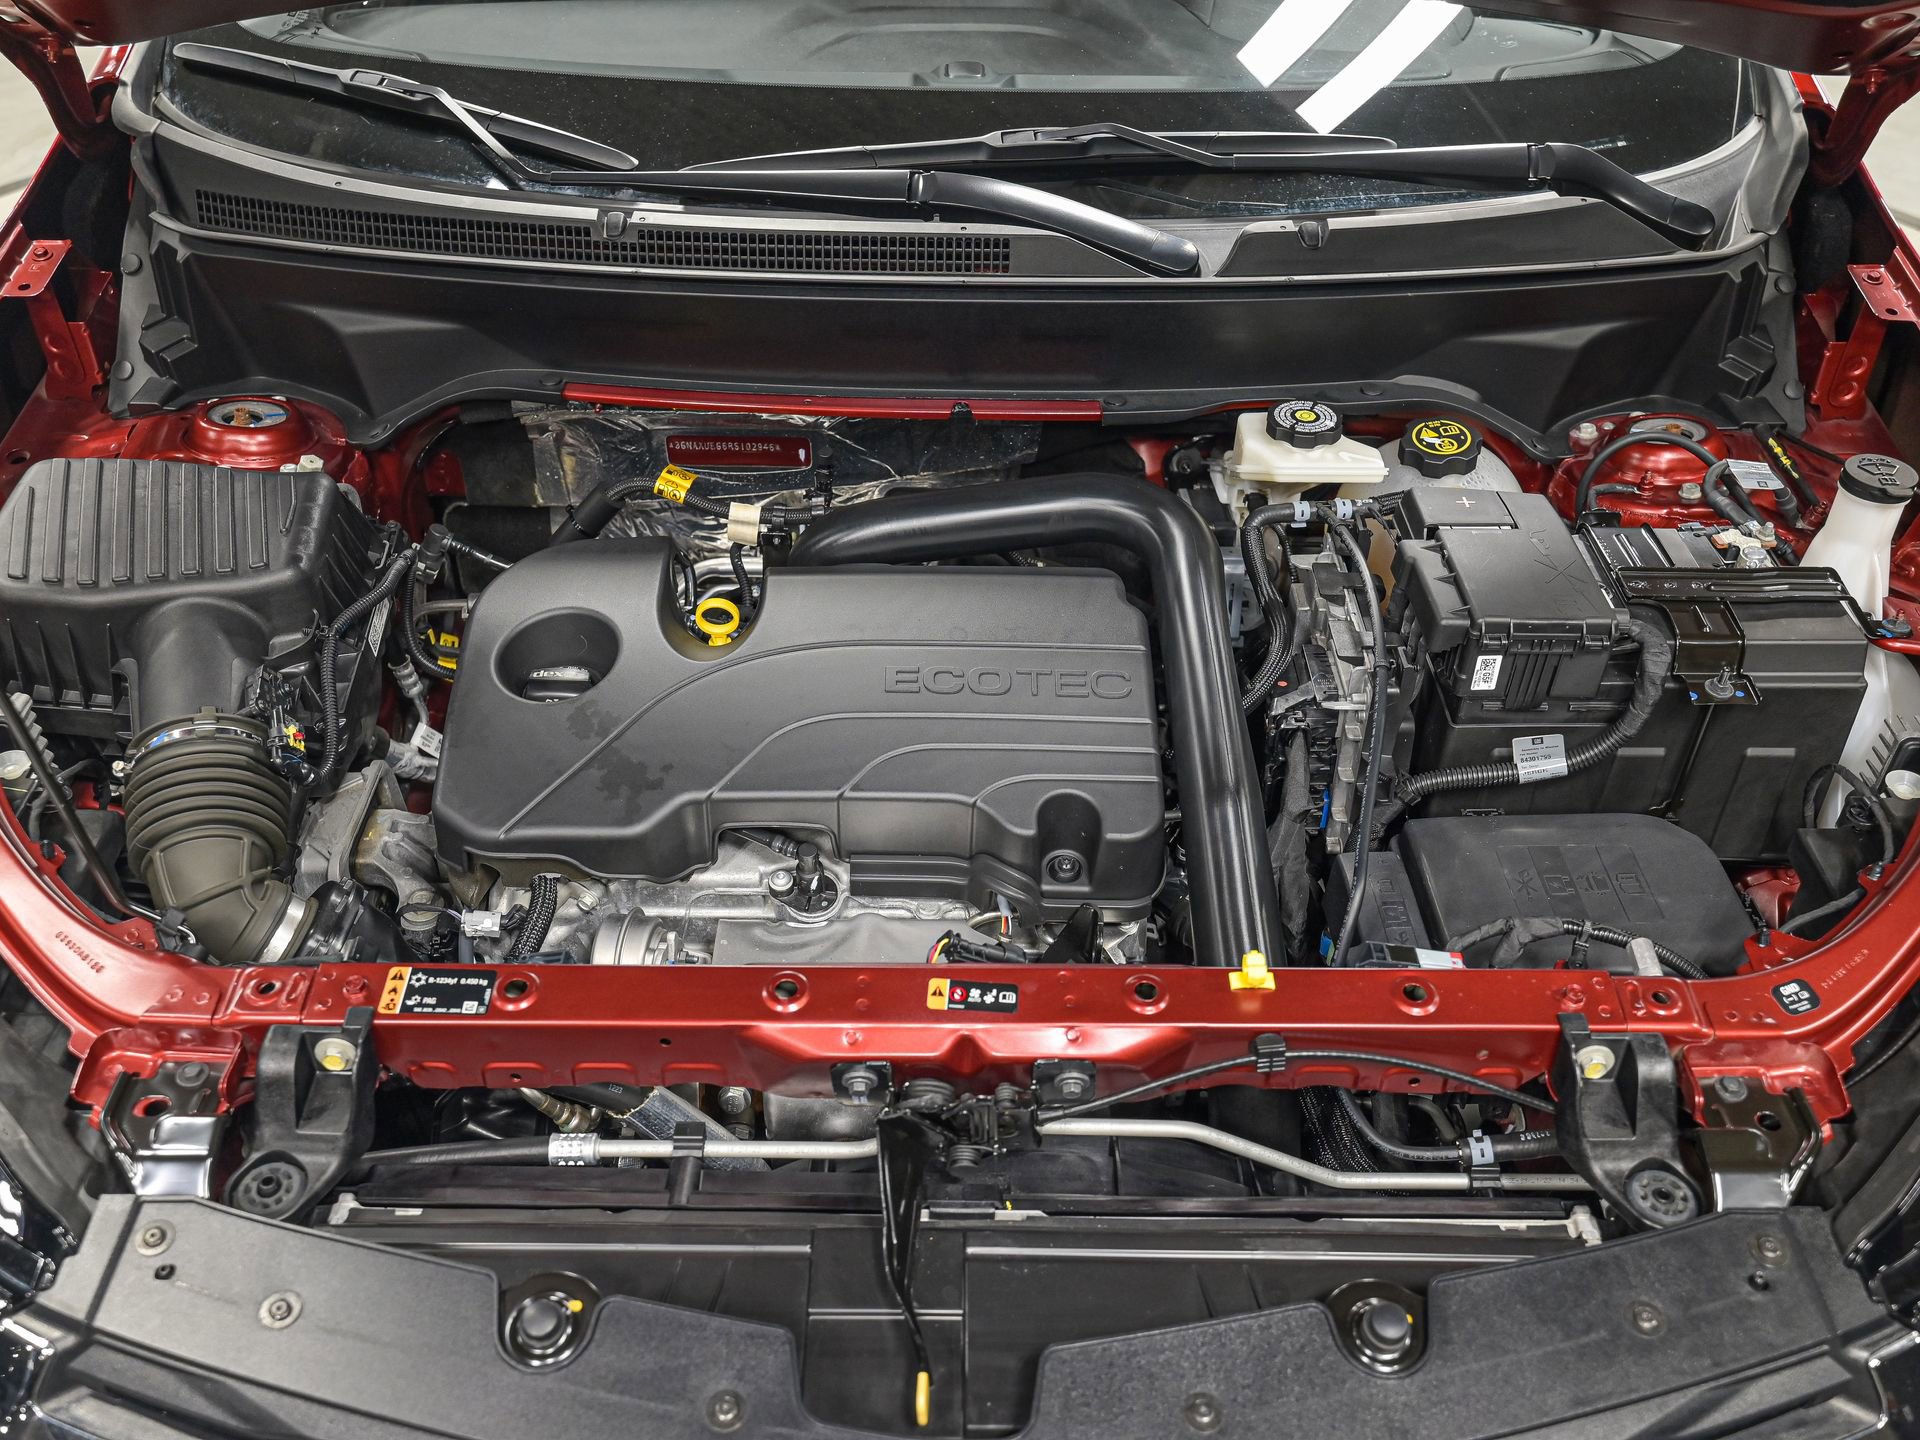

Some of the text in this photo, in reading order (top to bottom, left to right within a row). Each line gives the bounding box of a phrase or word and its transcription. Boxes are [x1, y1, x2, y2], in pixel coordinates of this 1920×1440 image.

[884, 665, 1133, 699] ECOTEC
[479, 978, 488, 987] kg
[608, 1083, 623, 1094] 1223
